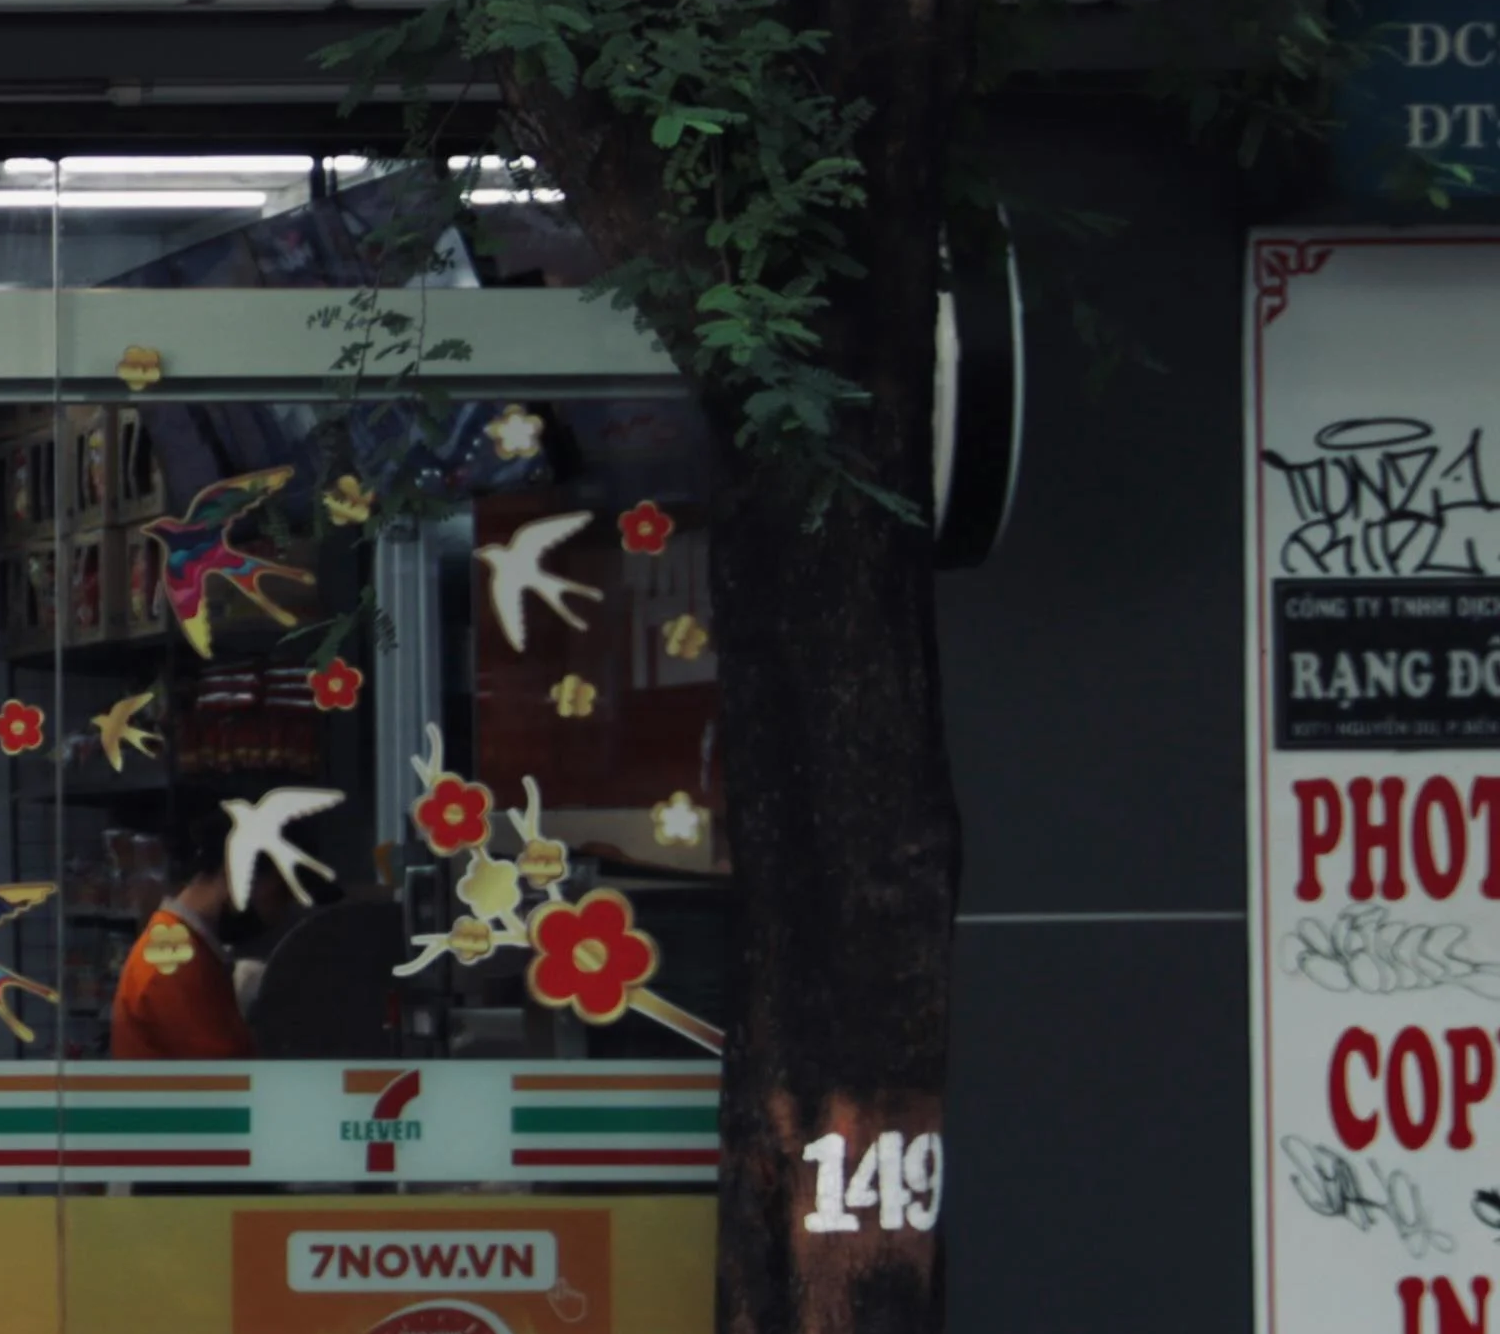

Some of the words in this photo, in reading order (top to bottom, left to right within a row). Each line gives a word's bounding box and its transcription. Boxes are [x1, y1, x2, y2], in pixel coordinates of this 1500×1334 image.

[1407, 22, 1496, 67] ĐC
[1289, 650, 1435, 710] RẠNG
[342, 1069, 420, 1173] 7
[1327, 1024, 1500, 1151] COP
[802, 1130, 944, 1232] 149
[309, 1243, 535, 1280] 7NOW.VN
